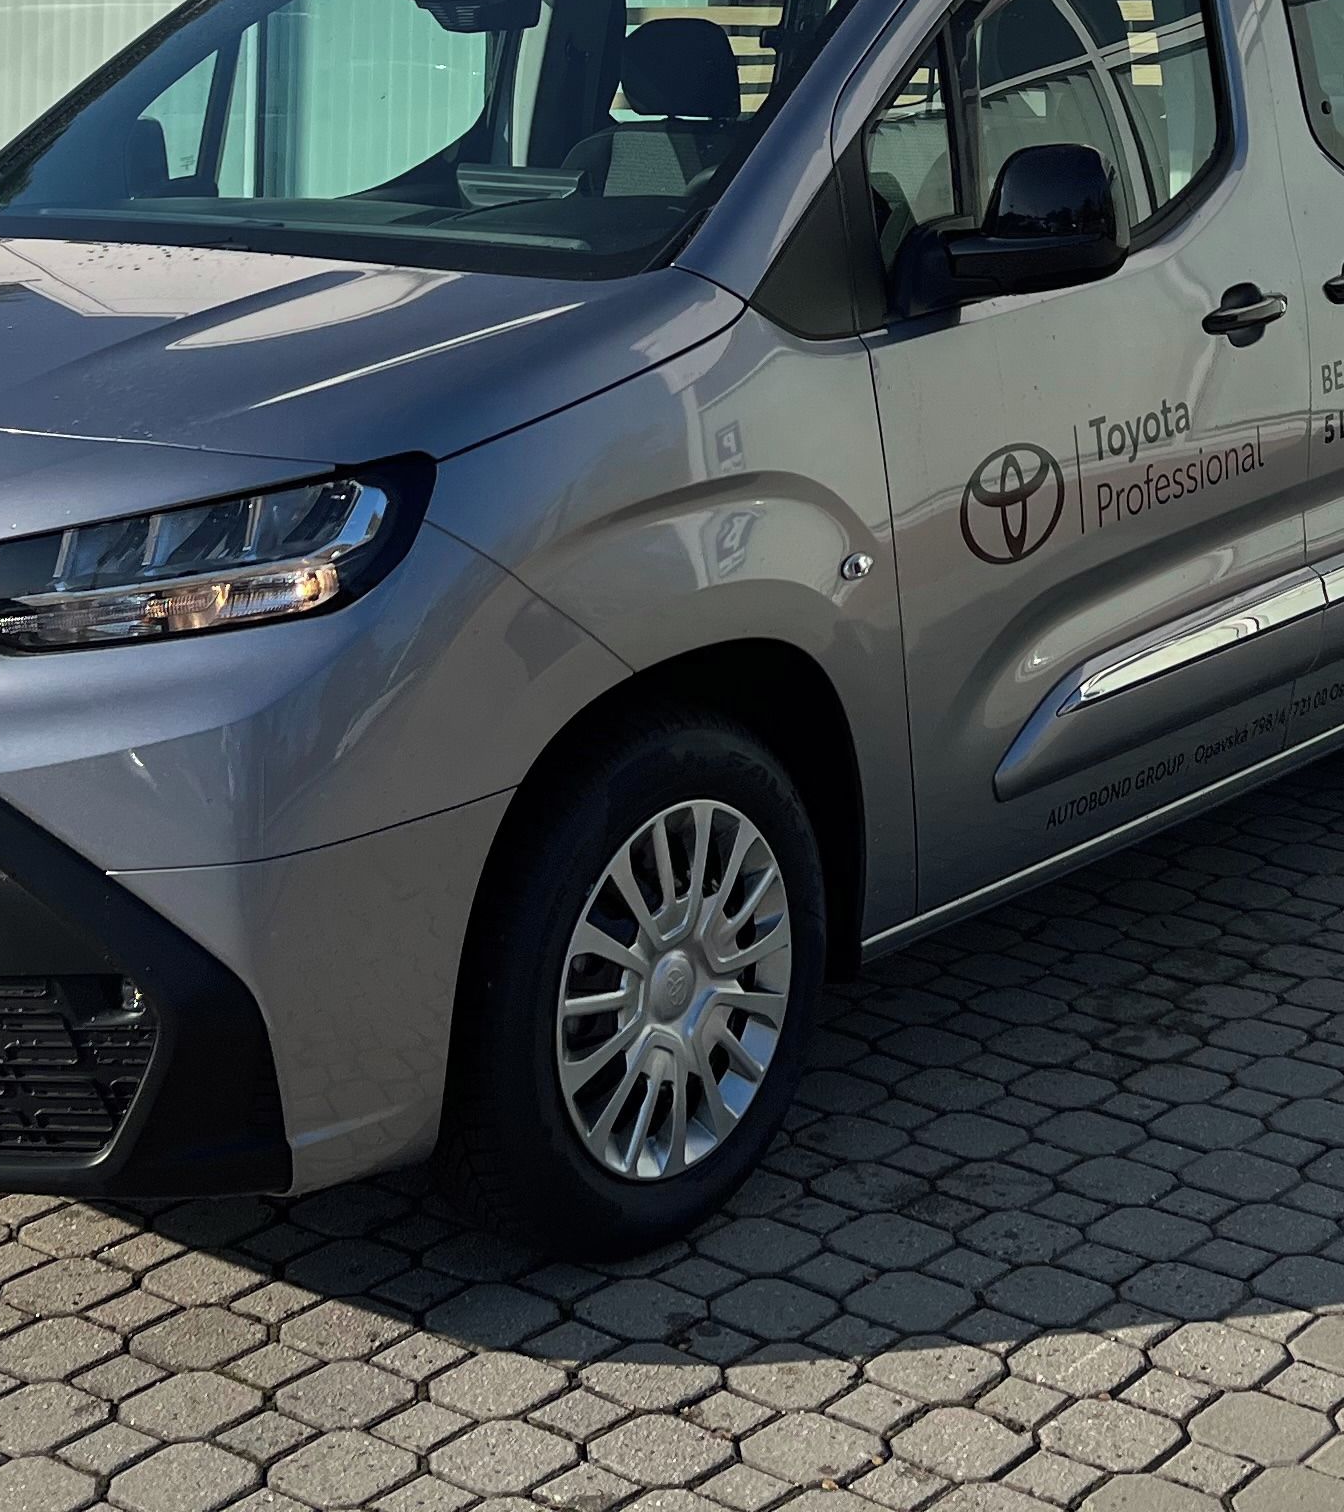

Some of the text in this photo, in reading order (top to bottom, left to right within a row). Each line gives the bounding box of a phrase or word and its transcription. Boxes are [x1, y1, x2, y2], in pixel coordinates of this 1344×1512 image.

[1088, 399, 1191, 464] Toyota
[1324, 414, 1335, 444] 5
[1096, 425, 1265, 529] Professional
[1045, 776, 1132, 831] AUTOBOND
